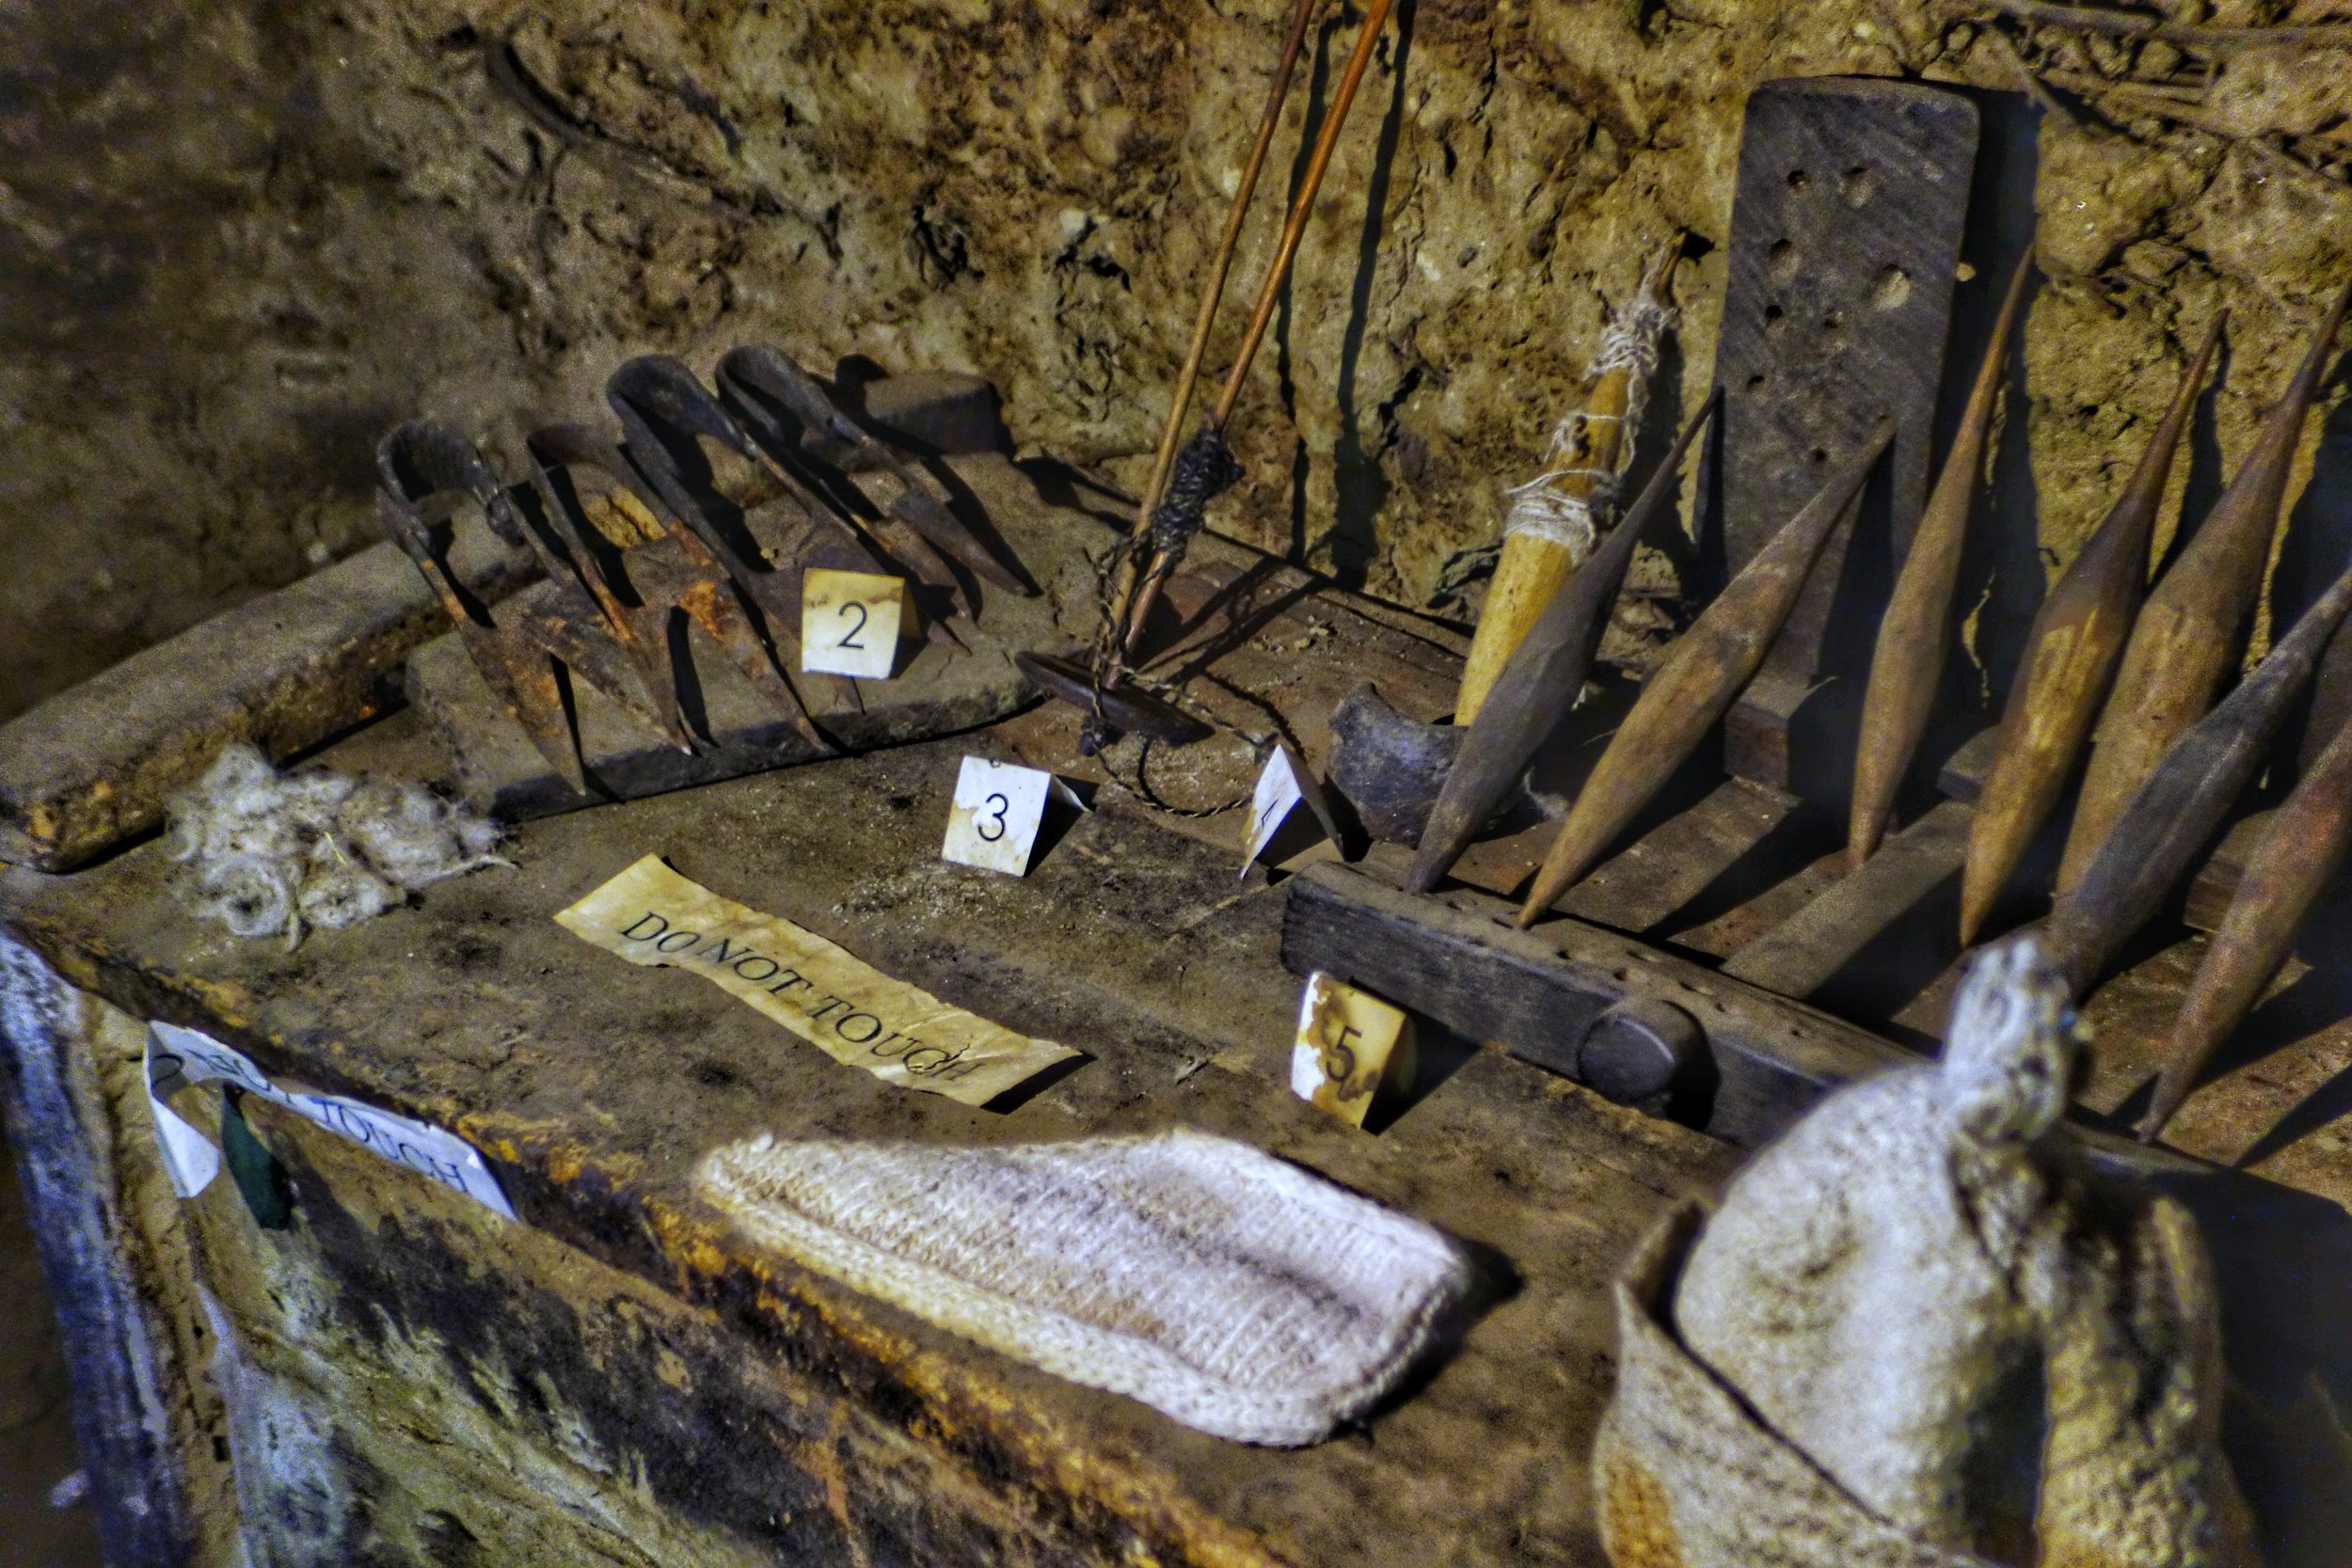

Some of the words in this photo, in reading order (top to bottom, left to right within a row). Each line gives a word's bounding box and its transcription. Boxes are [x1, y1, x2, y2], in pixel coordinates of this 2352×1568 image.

[837, 600, 867, 649] 2
[977, 793, 1009, 842] 3
[619, 911, 701, 953] DO
[696, 939, 814, 995] NOT
[806, 995, 986, 1082] TOUCH
[1327, 1025, 1362, 1082] 5
[305, 1095, 469, 1193] TOUCH
